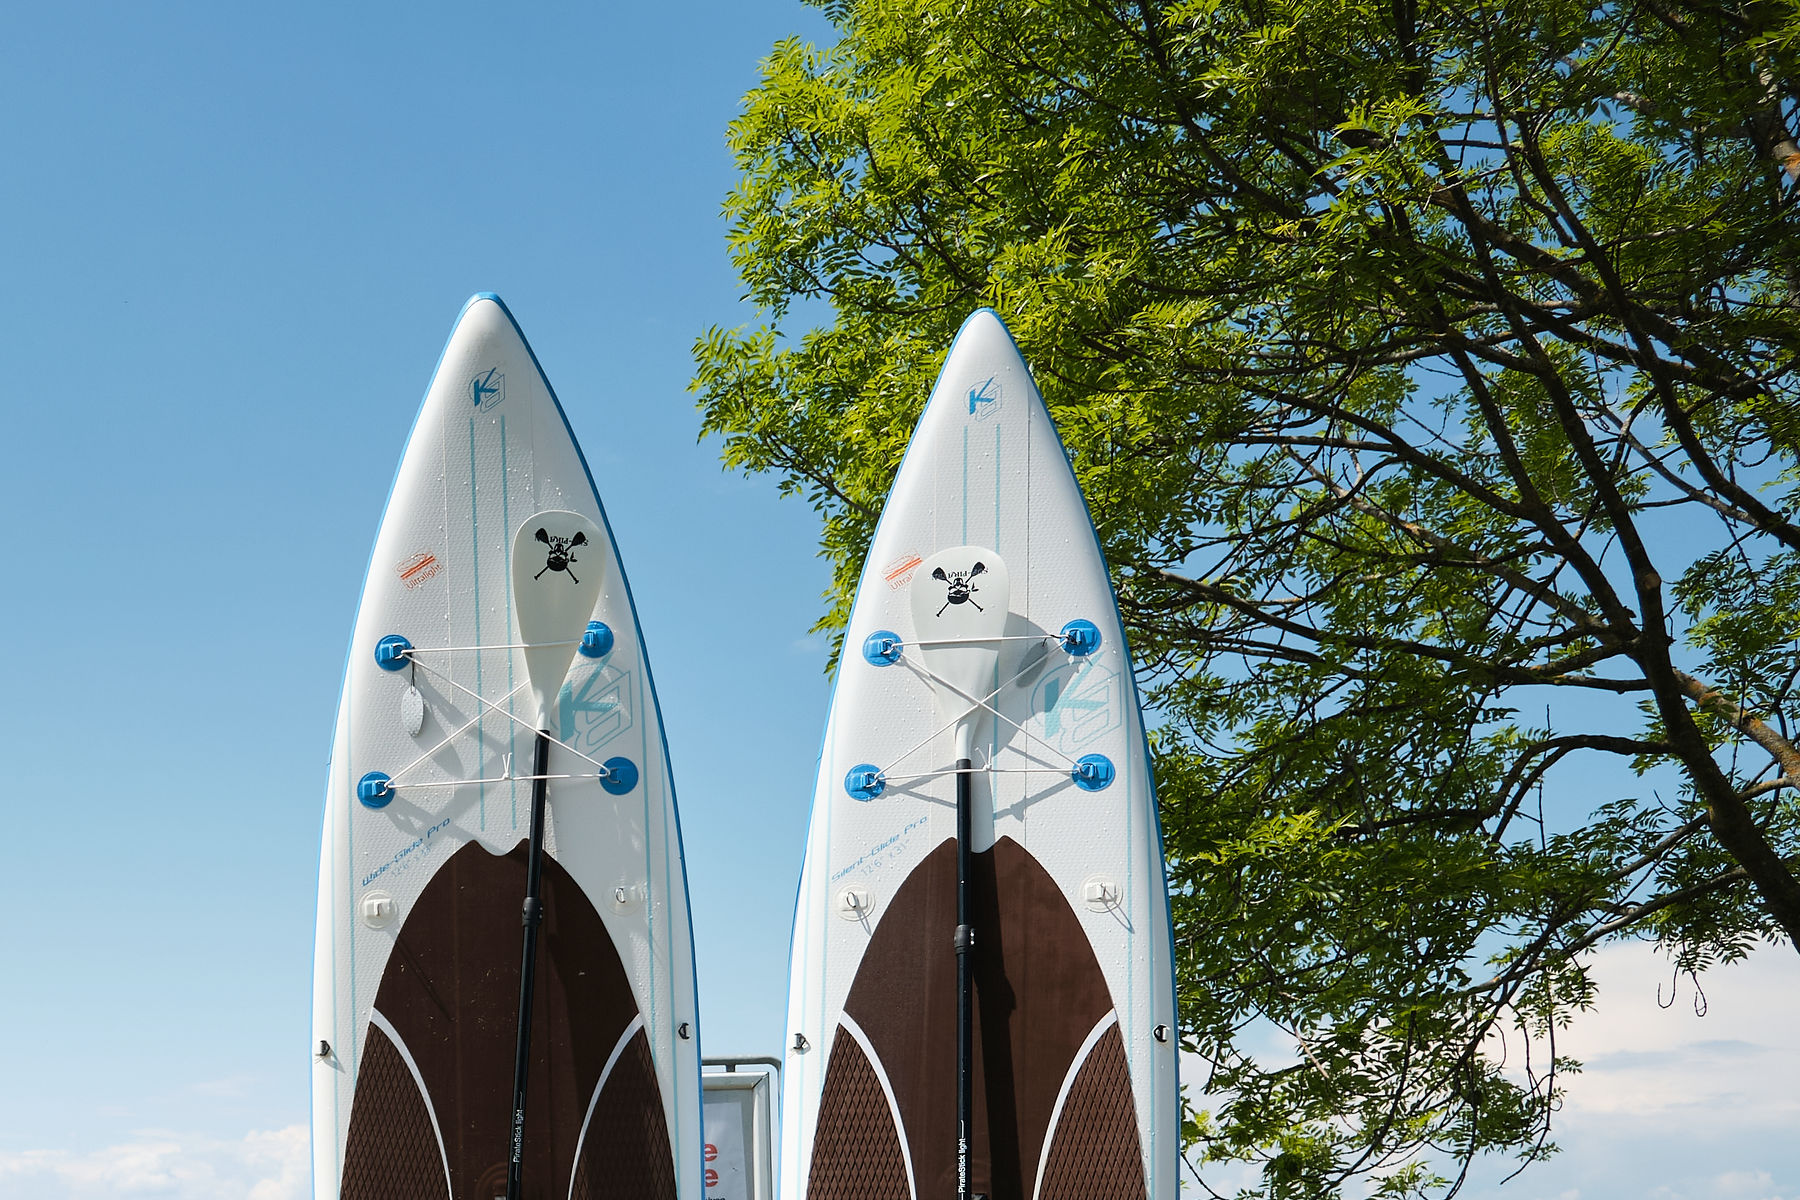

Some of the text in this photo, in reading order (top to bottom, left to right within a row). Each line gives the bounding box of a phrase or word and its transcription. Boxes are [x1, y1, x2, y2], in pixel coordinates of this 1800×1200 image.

[406, 563, 442, 589] Ultralight
[904, 816, 928, 835] Pro
[362, 818, 451, 887] Wide-Glide Pro
[958, 1138, 967, 1193] PirateStick light
